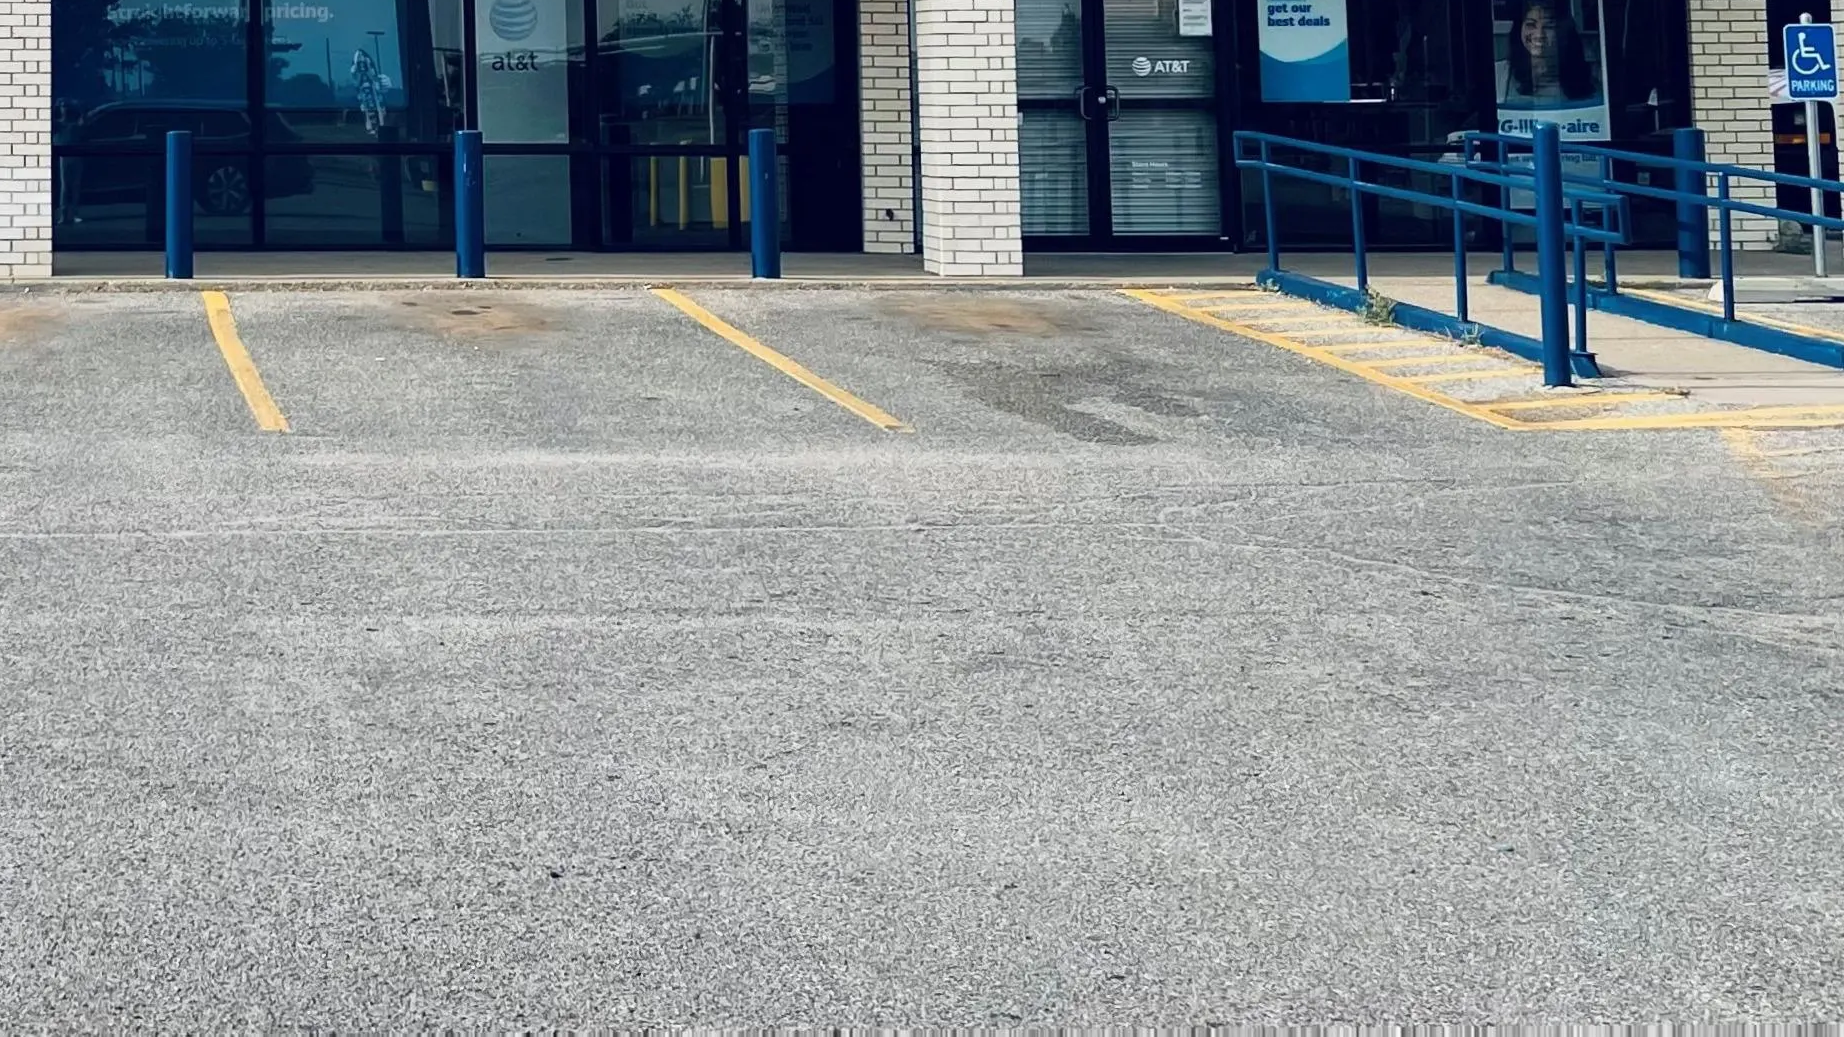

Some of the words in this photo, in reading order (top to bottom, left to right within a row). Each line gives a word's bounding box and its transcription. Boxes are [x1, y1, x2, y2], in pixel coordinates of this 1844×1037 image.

[264, 1, 334, 23] pricing.
[1267, 3, 1289, 16] get
[1291, 5, 1312, 13] our
[1267, 16, 1295, 27] best
[1298, 15, 1330, 27] deals
[1154, 60, 1190, 73] AT&T
[1791, 79, 1835, 94] PARKING
